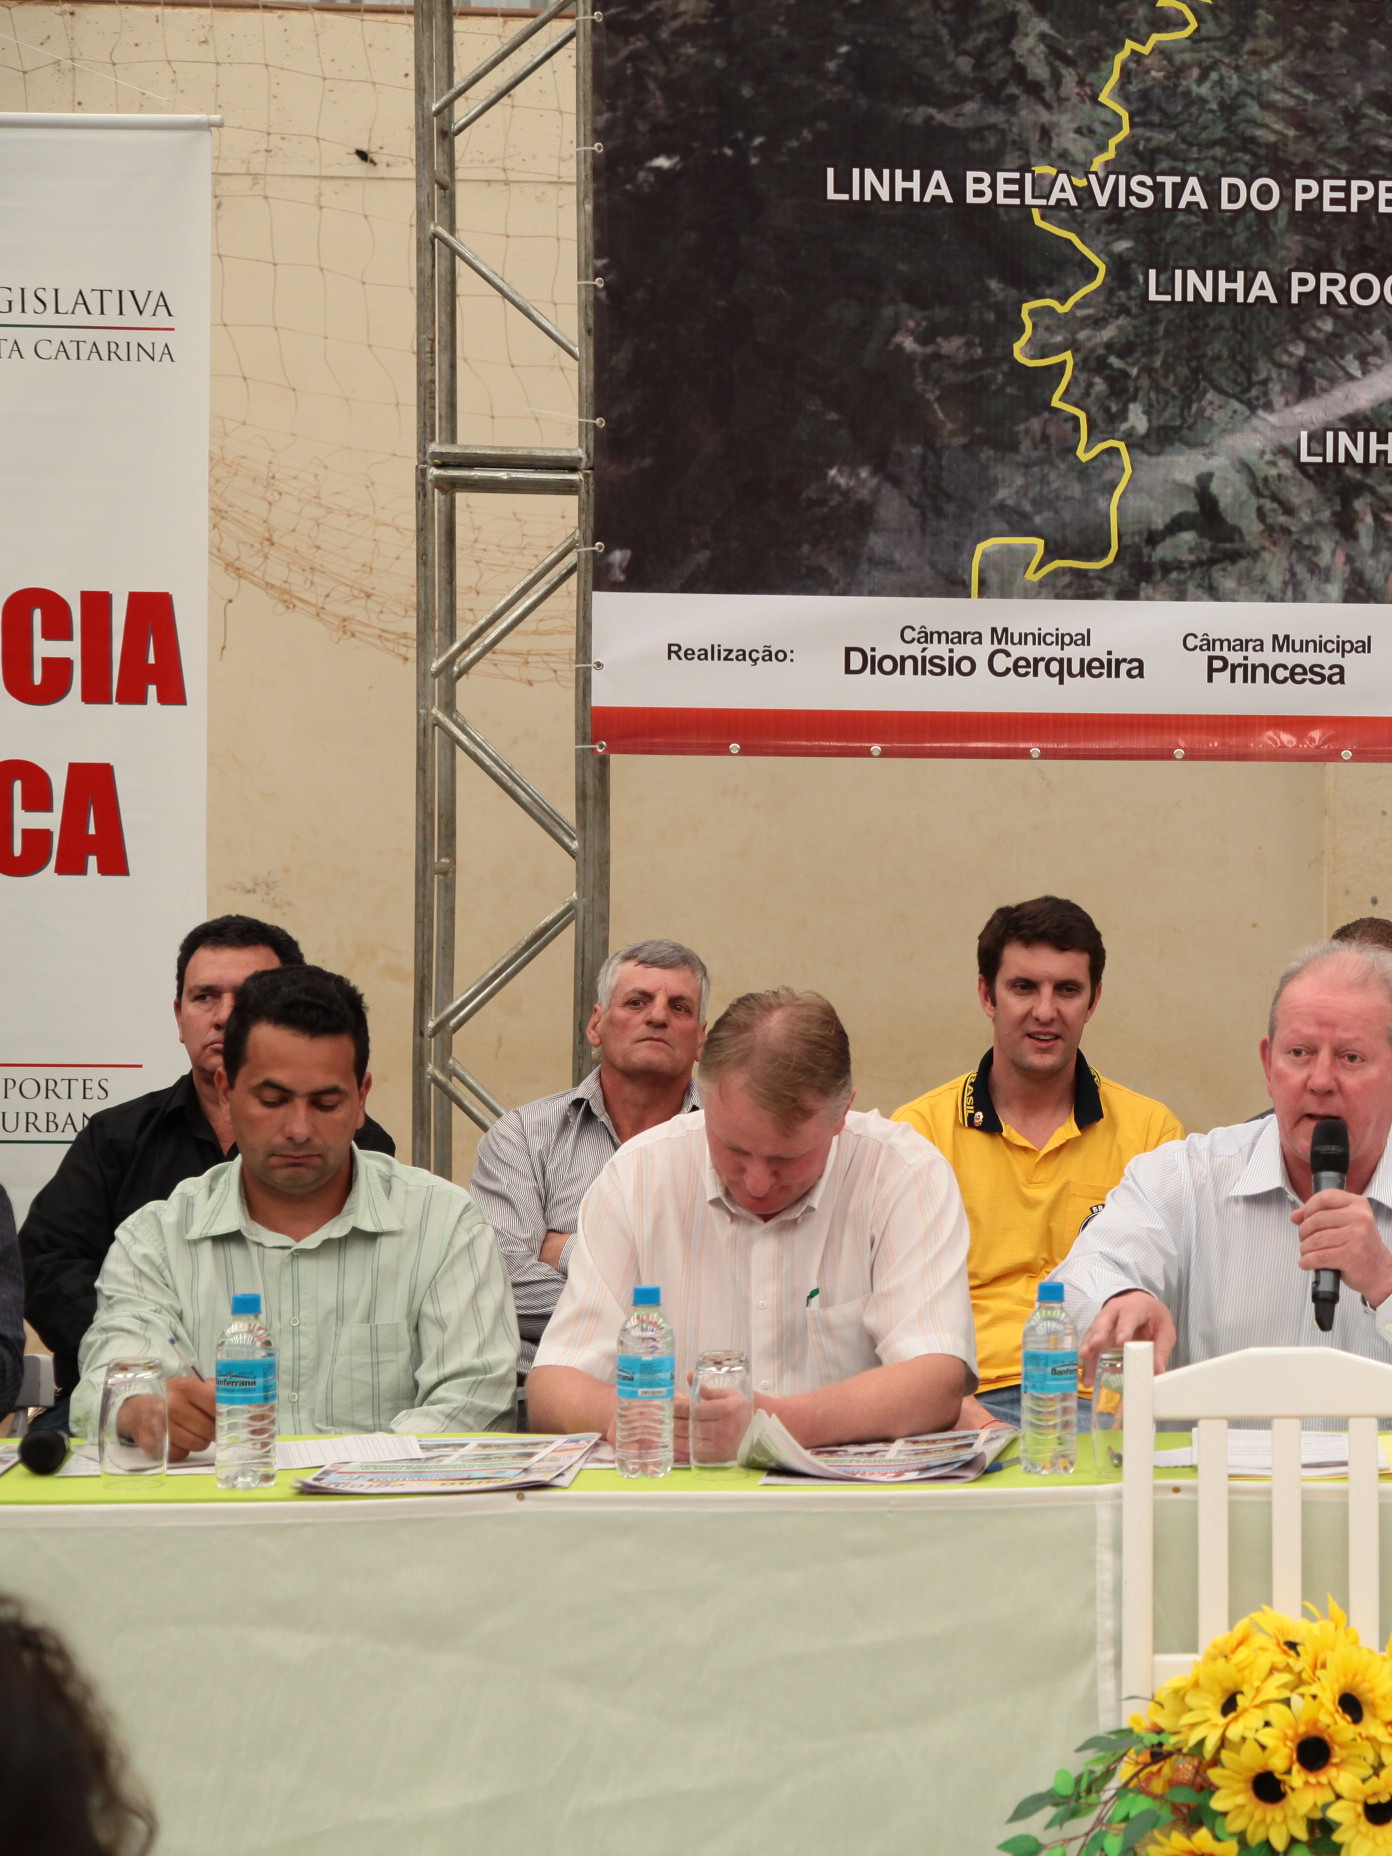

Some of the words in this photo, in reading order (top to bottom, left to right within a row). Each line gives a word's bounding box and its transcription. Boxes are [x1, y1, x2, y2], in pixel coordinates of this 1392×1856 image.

[826, 167, 952, 203] LINHA
[966, 171, 1077, 206] BELA
[1089, 174, 1208, 209] VISTA
[1221, 176, 1281, 211] DO
[1147, 269, 1277, 303] LINHA
[34, 339, 176, 362] CATARINA
[0, 587, 188, 706] CIA
[899, 624, 984, 646] Câmara
[990, 627, 1092, 651] Municipal
[1181, 632, 1266, 654] Câmara
[1272, 635, 1373, 659] Municipal
[666, 642, 796, 666] Realização:
[843, 646, 977, 677] Dionísio
[986, 648, 1145, 684] Cerqueira
[1205, 655, 1346, 685] Princesa
[0, 759, 130, 877] CA
[3, 1077, 109, 1101] PORTES
